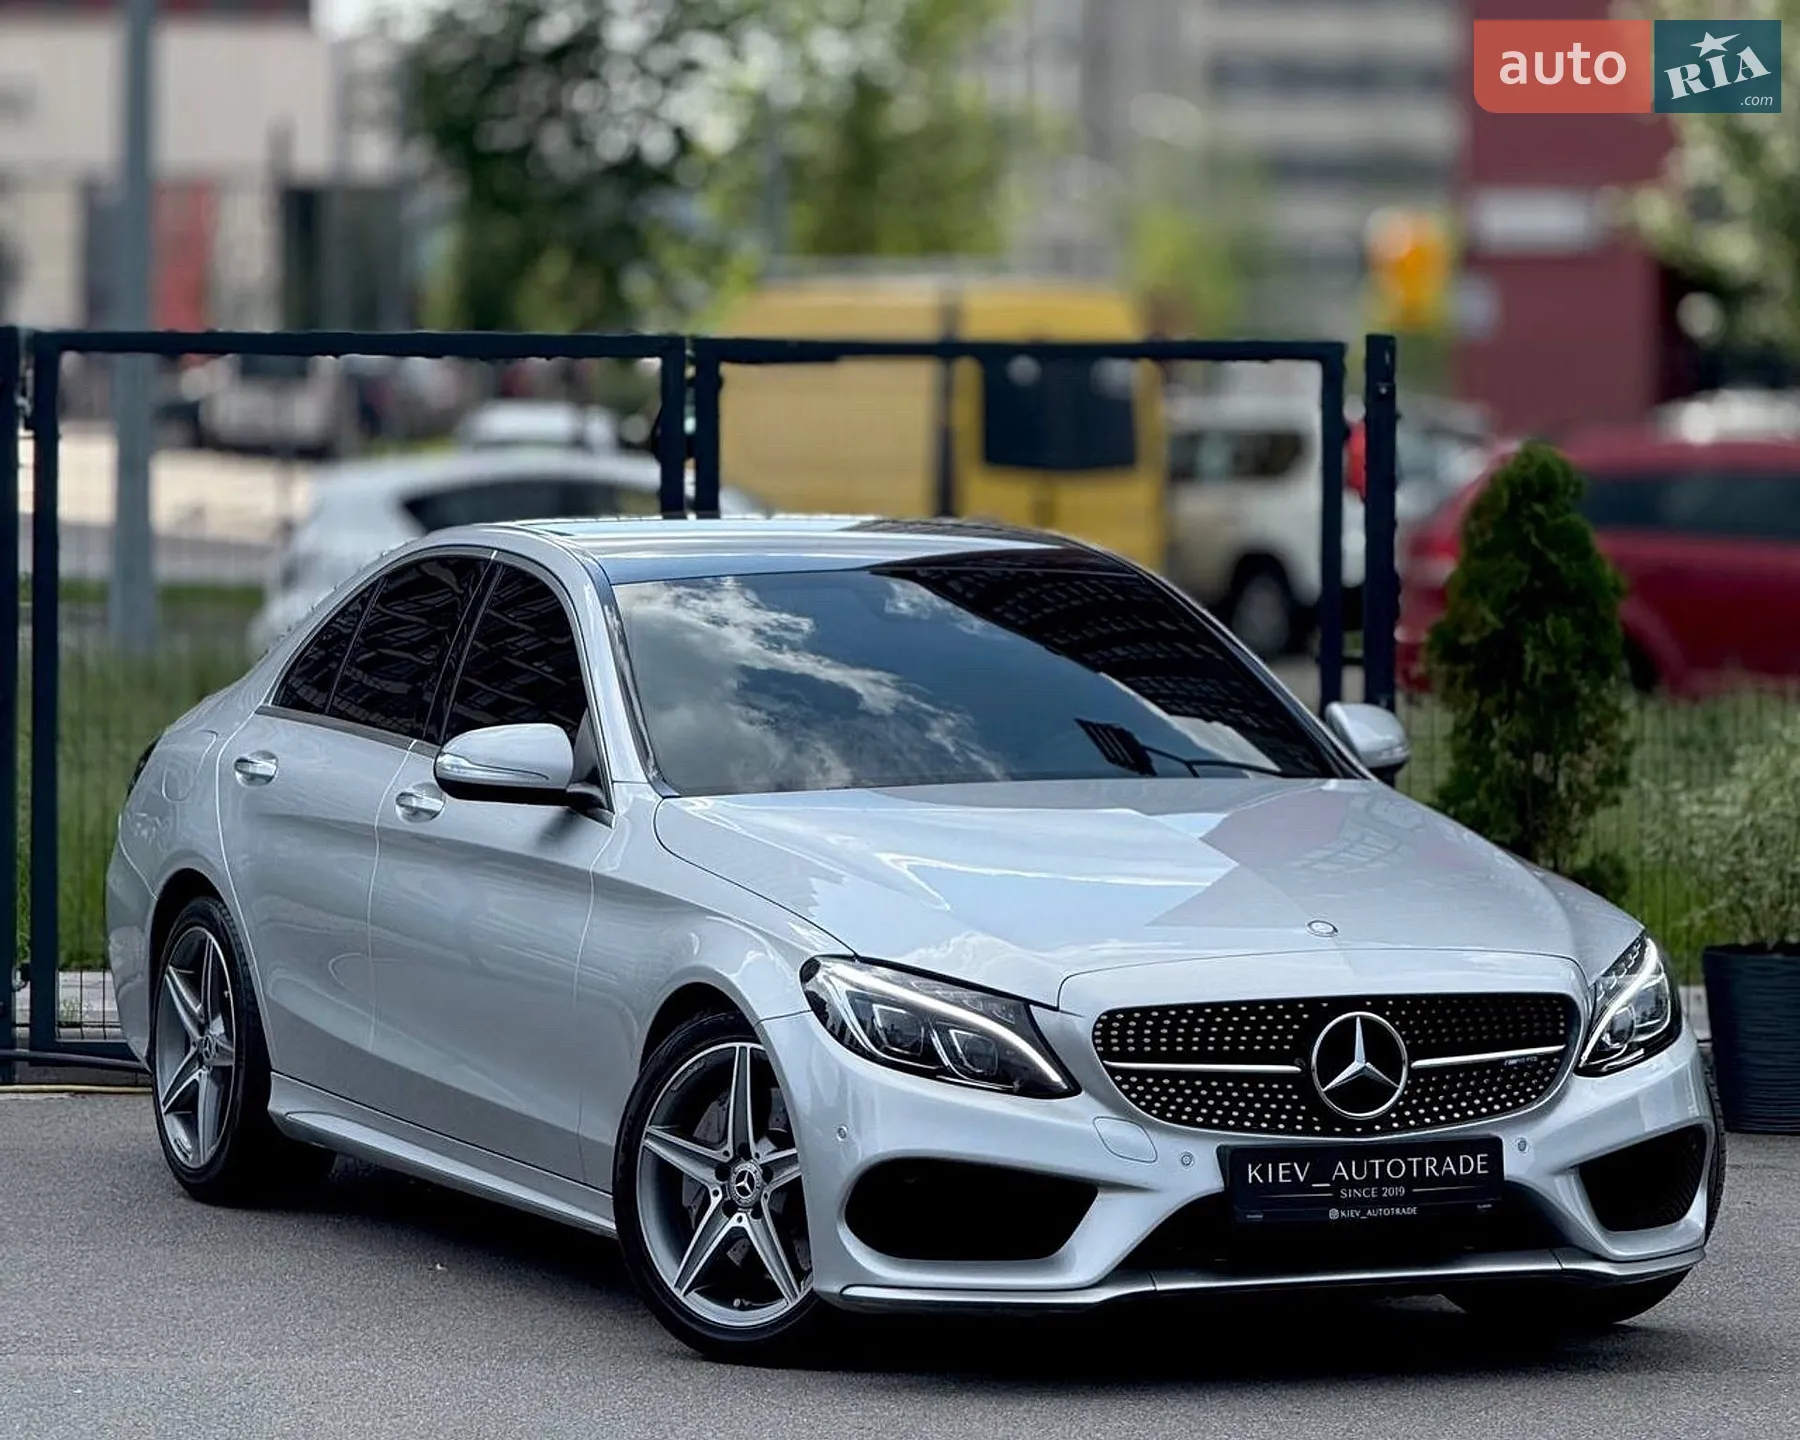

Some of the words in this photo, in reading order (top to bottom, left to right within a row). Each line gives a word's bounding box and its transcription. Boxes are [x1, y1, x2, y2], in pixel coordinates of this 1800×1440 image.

[1247, 1153, 1490, 1188] KIEV_AUTOTRADE
[1339, 1187, 1379, 1199] SINCE
[1381, 1185, 1406, 1197] 2019
